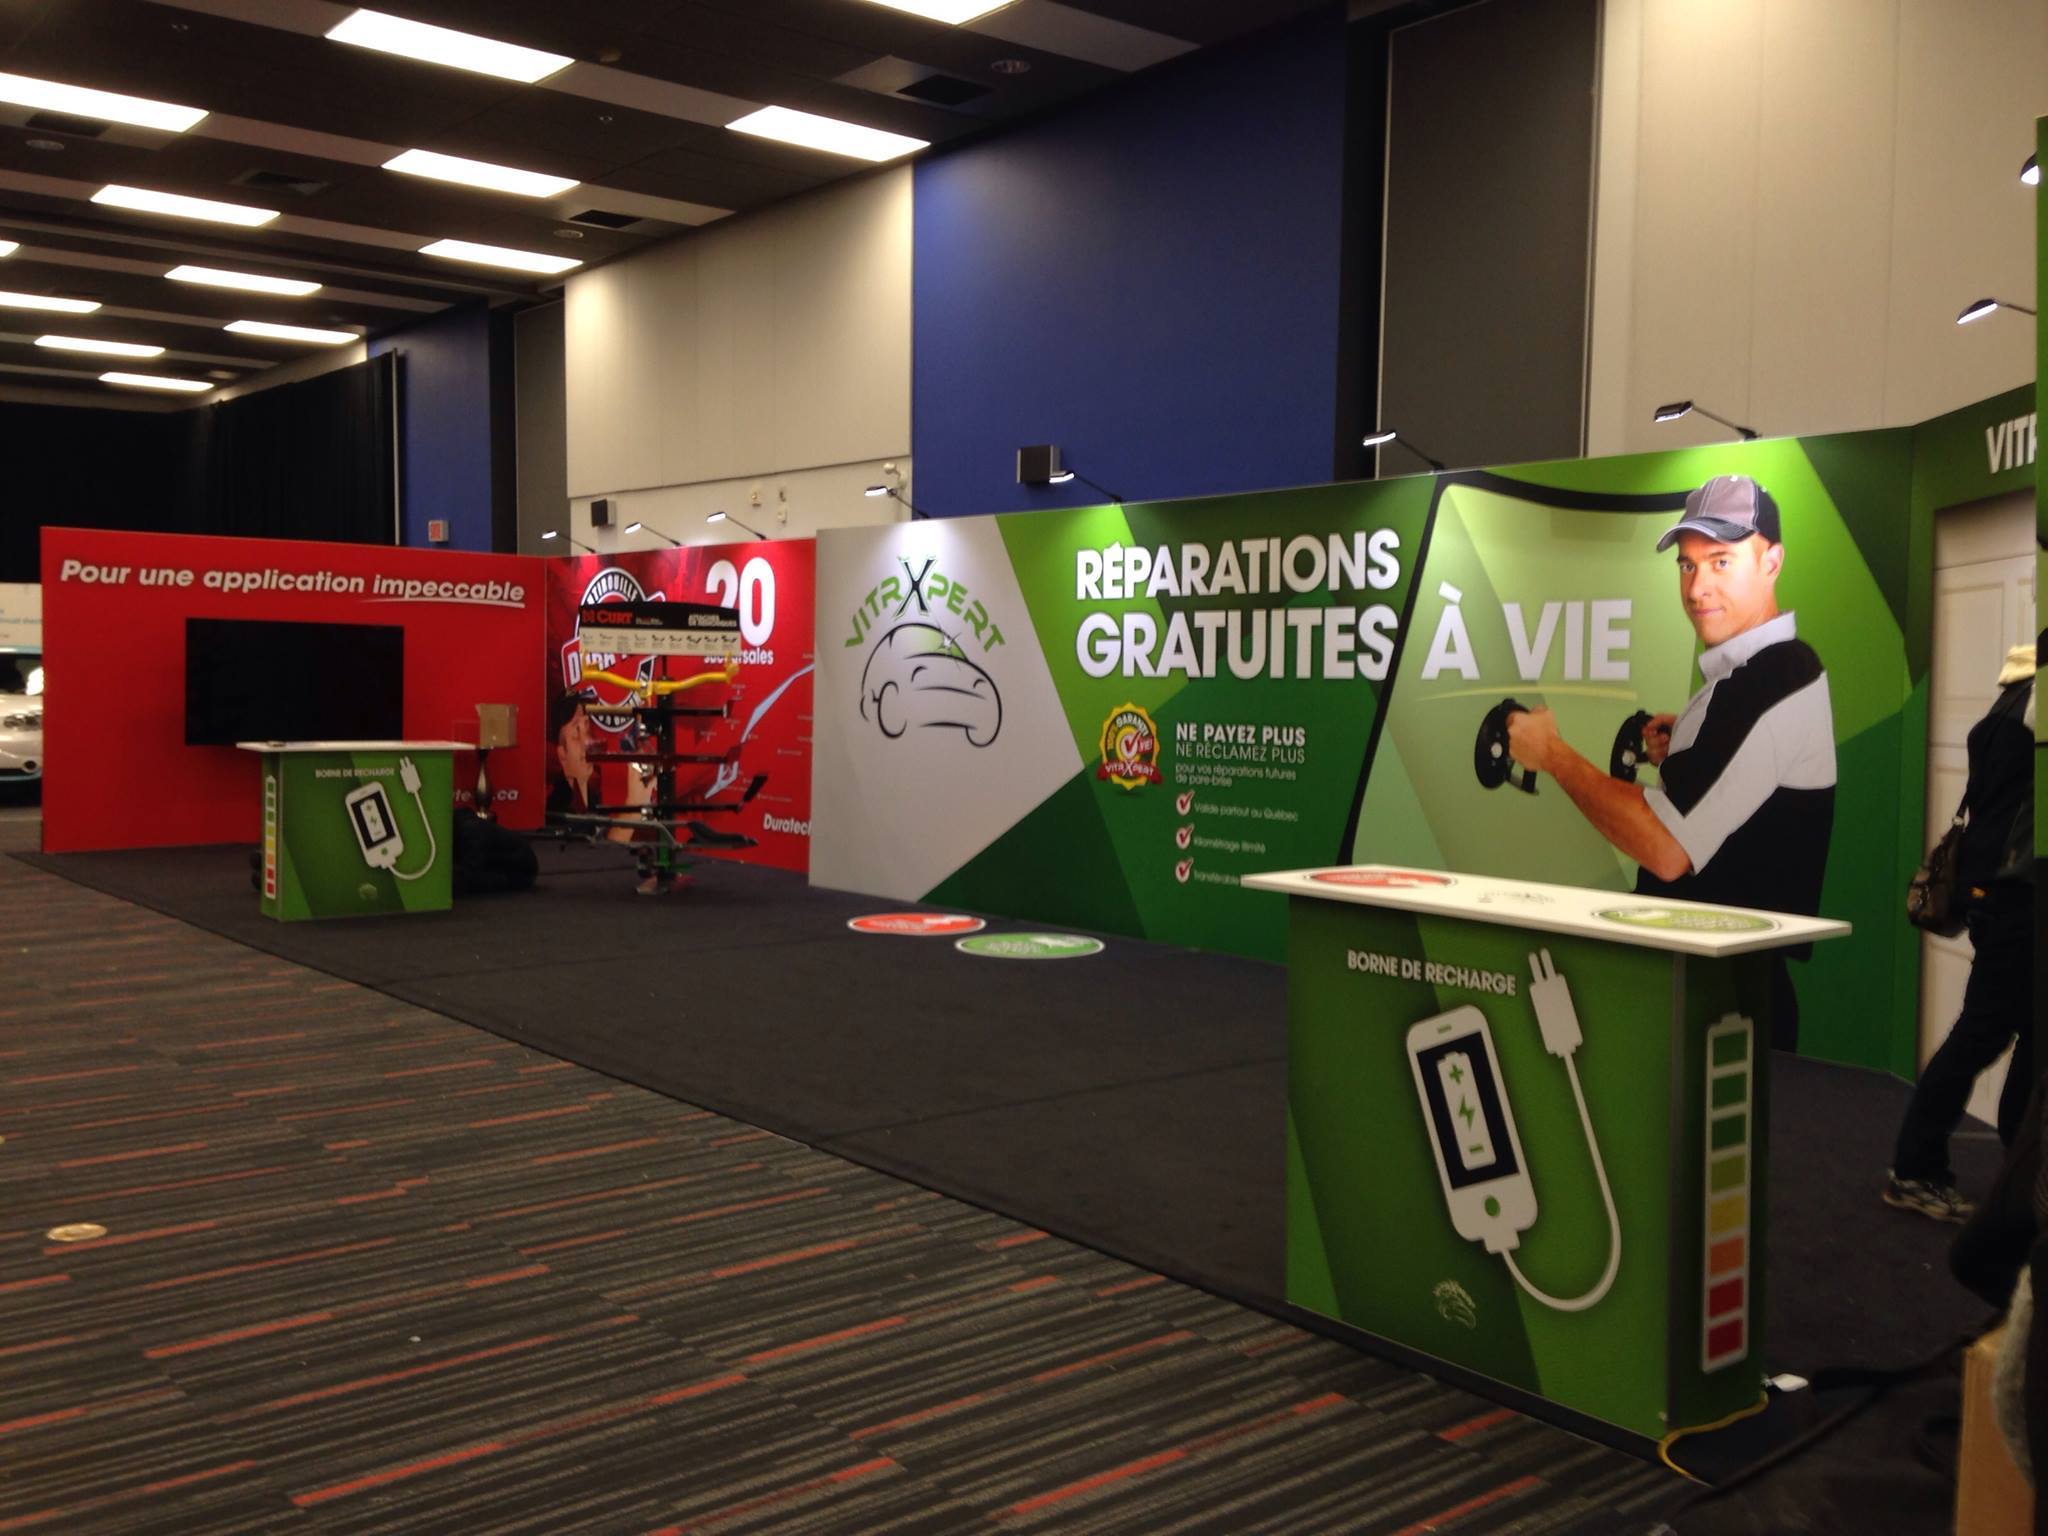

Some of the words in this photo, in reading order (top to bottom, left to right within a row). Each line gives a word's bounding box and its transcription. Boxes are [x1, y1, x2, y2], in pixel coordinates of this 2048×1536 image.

[60, 559, 131, 584] Pour
[139, 568, 195, 587] une
[203, 569, 365, 593] application
[372, 574, 525, 602] impeccable
[1076, 528, 1400, 600] RÉPARATIONS
[705, 556, 775, 646] 20
[1076, 603, 1398, 681] GRATUITES
[1421, 582, 1480, 680] À
[1503, 599, 1632, 680] VIE
[1176, 722, 1197, 741] NE
[1204, 723, 1256, 744] PAYEZ
[1262, 725, 1305, 747] PLUS
[1176, 742, 1192, 757] NE
[1196, 742, 1267, 762] RÉCLAMEZ
[1272, 747, 1305, 764] PLUS
[1176, 763, 1195, 775] pour
[1347, 949, 1398, 977] BORNE
[1401, 958, 1421, 981] DE
[1425, 962, 1516, 996] RECHARGE
